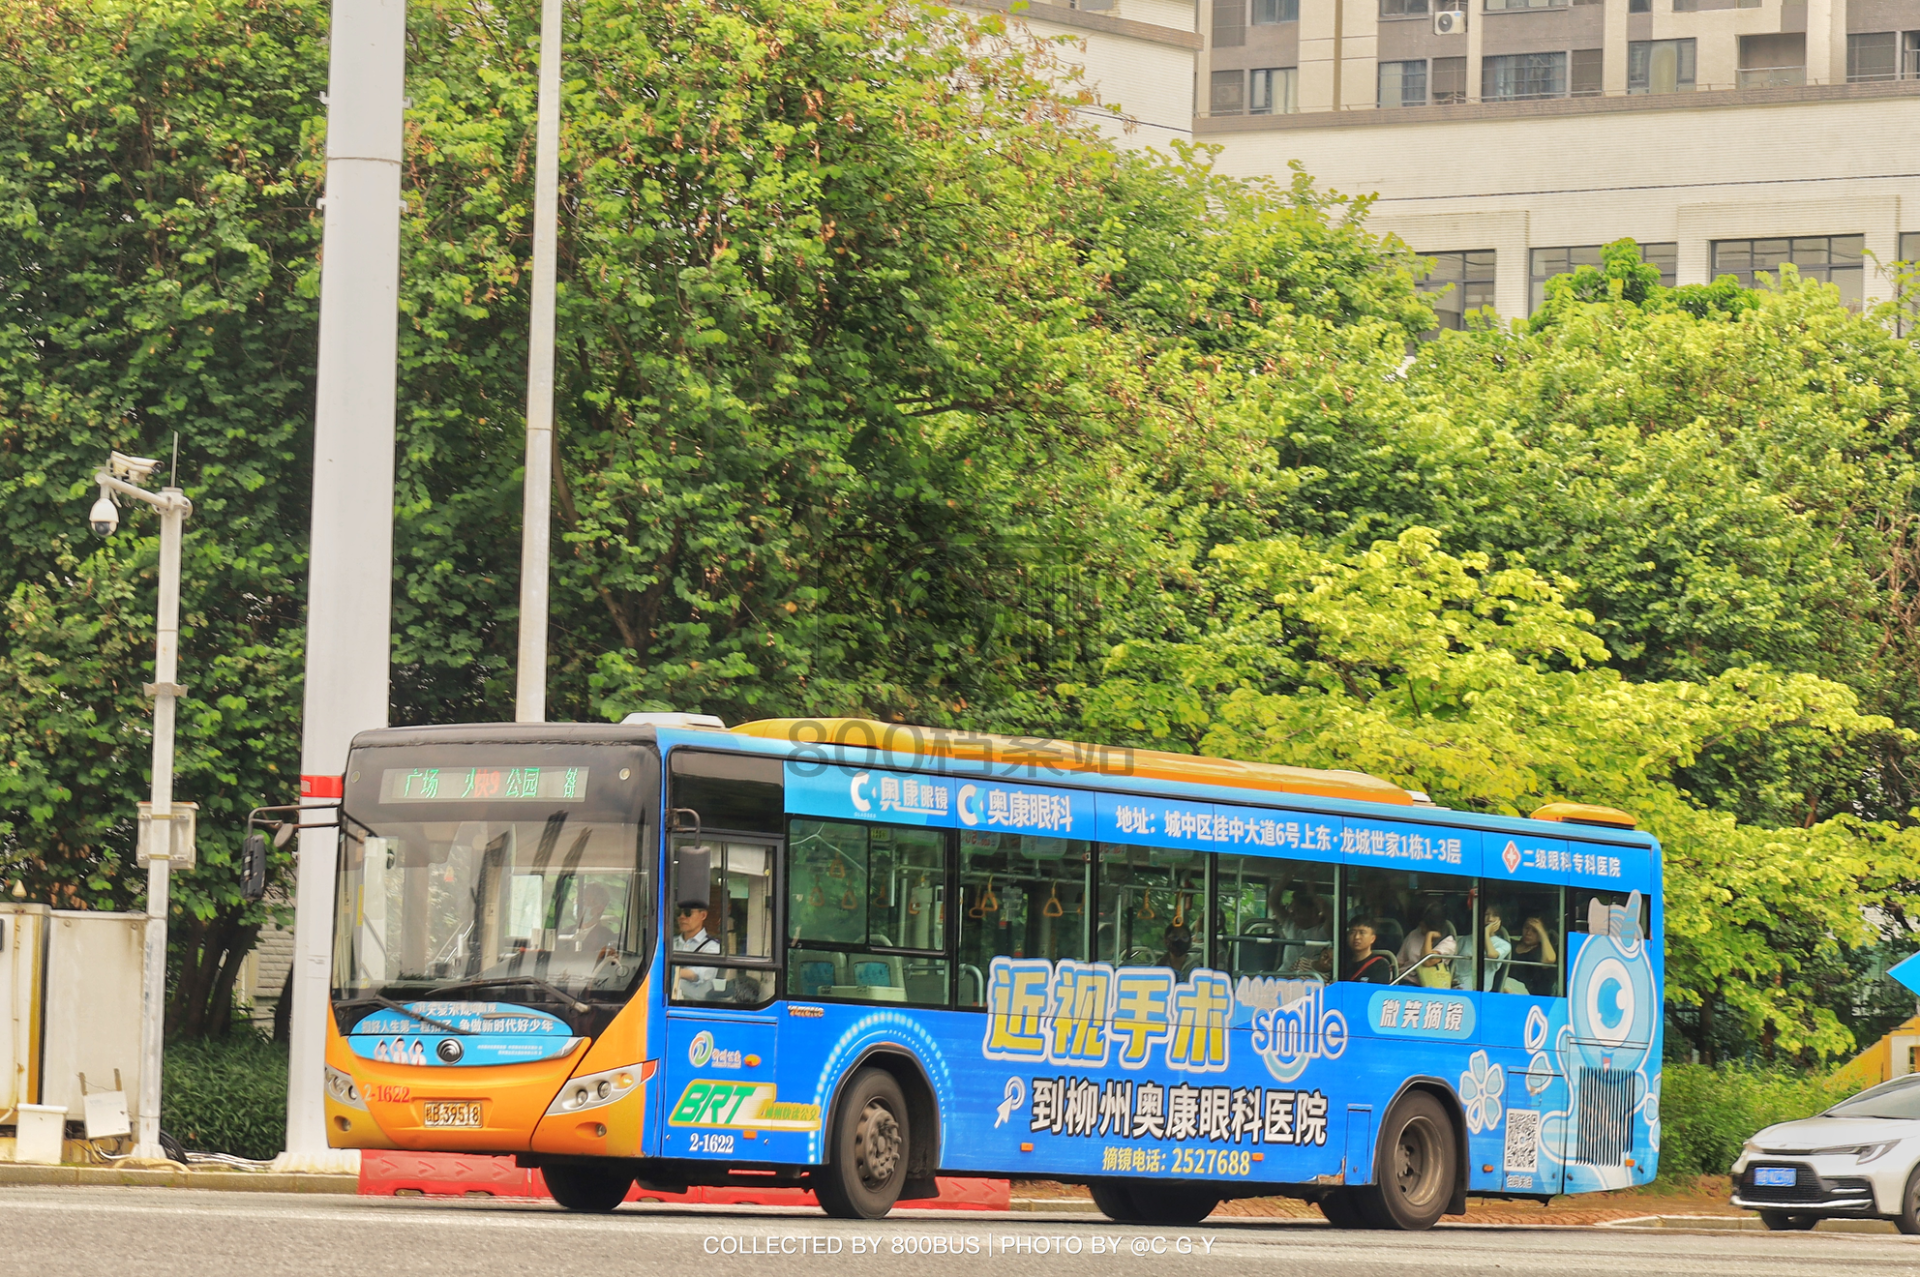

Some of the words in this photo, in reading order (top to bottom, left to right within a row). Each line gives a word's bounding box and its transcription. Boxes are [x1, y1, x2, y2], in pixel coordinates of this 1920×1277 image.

[404, 768, 439, 798] 广场
[505, 767, 540, 798] 公园
[880, 777, 948, 815] 奥康眼镜
[988, 788, 1073, 832] 奥康眼科
[1523, 849, 1621, 877] 二级眼科专科医院
[985, 957, 1233, 1071] 近视手术
[1380, 999, 1464, 1032] 微笑摘镜
[363, 1083, 411, 1103] 2-1622
[672, 1083, 757, 1124] BRT
[1031, 1076, 1327, 1146] 到柳州奥康眼科医院
[689, 1133, 734, 1152] 2-1622
